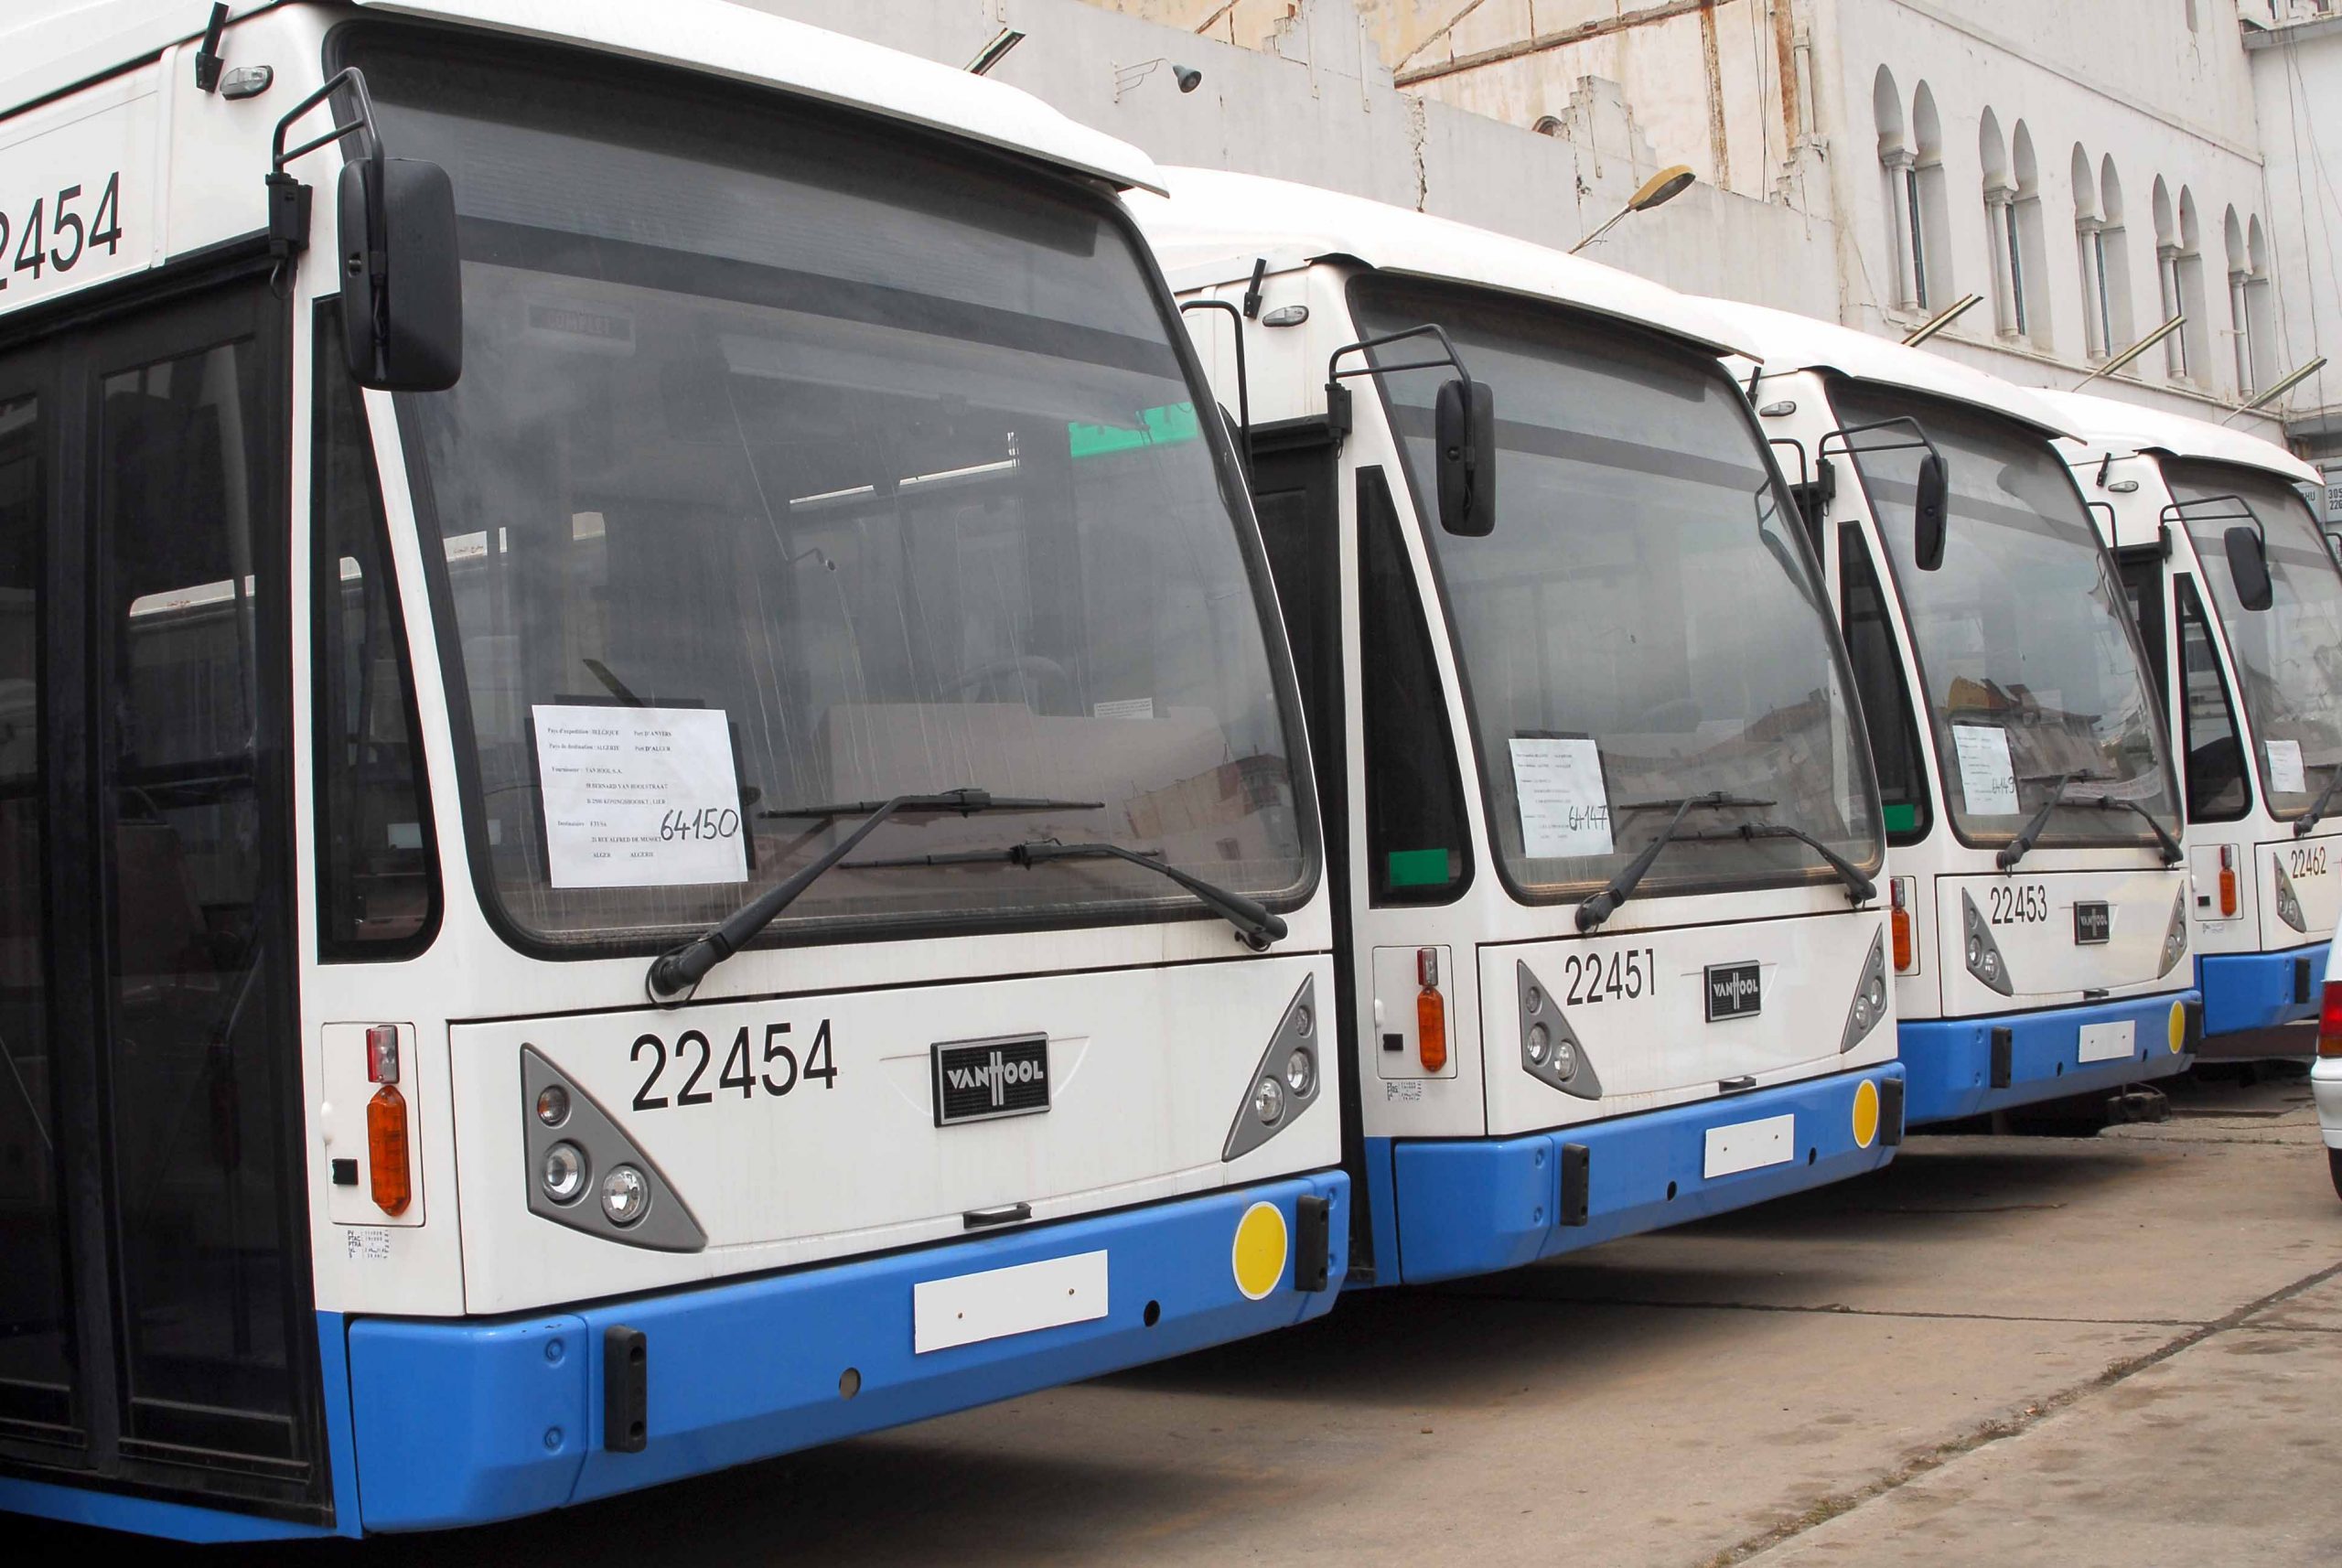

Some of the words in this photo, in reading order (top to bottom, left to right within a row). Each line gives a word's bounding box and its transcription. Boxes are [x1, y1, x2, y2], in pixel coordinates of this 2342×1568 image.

[661, 808, 739, 841] 64150
[1568, 805, 1608, 832] 64147
[2291, 846, 2326, 879] 22462
[1990, 885, 2047, 924] 22453
[1564, 948, 1655, 1006] 22451
[629, 1018, 839, 1112] 22454
